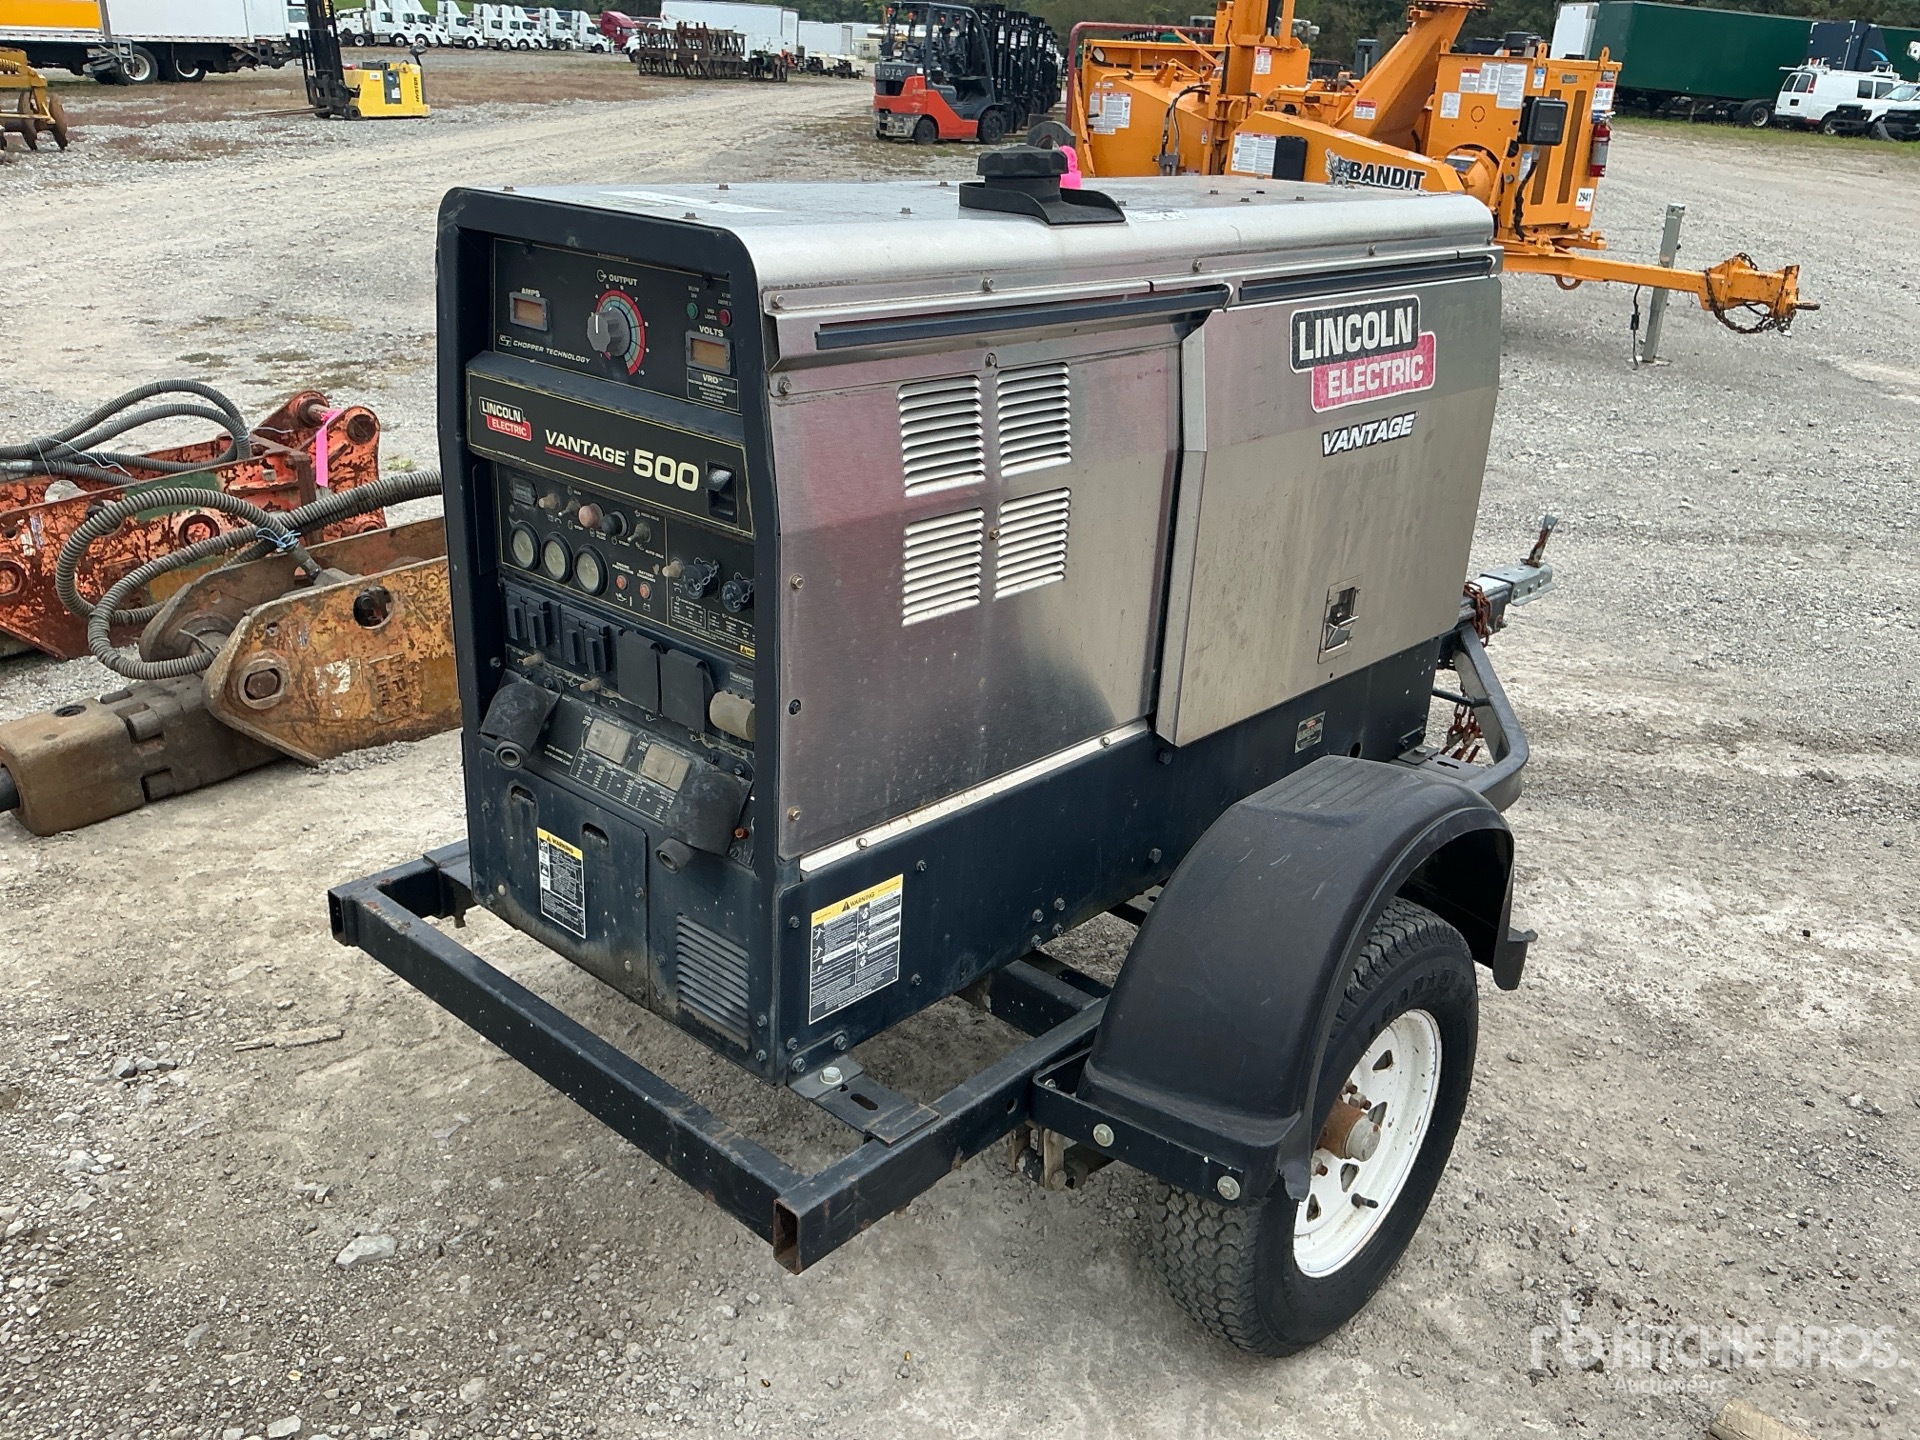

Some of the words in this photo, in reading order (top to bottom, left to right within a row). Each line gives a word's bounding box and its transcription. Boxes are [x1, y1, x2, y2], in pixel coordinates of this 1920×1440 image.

[1348, 160, 1426, 191] BANDIT
[608, 273, 638, 287] OUTPUT
[520, 287, 541, 298] AMPS
[699, 324, 725, 337] VOLTS
[1299, 306, 1414, 361] LINCOLN
[513, 340, 545, 353] CHOPPER
[546, 347, 591, 364] TECHNOLOGY
[1327, 354, 1424, 400] ELECTRIC
[481, 400, 522, 423] LINCOLN
[491, 418, 528, 437] ELECTRIC
[1322, 411, 1417, 457] VANTAGE
[545, 429, 626, 468] VANTAGE
[633, 448, 700, 492] 500
[850, 891, 875, 907] WARNING
